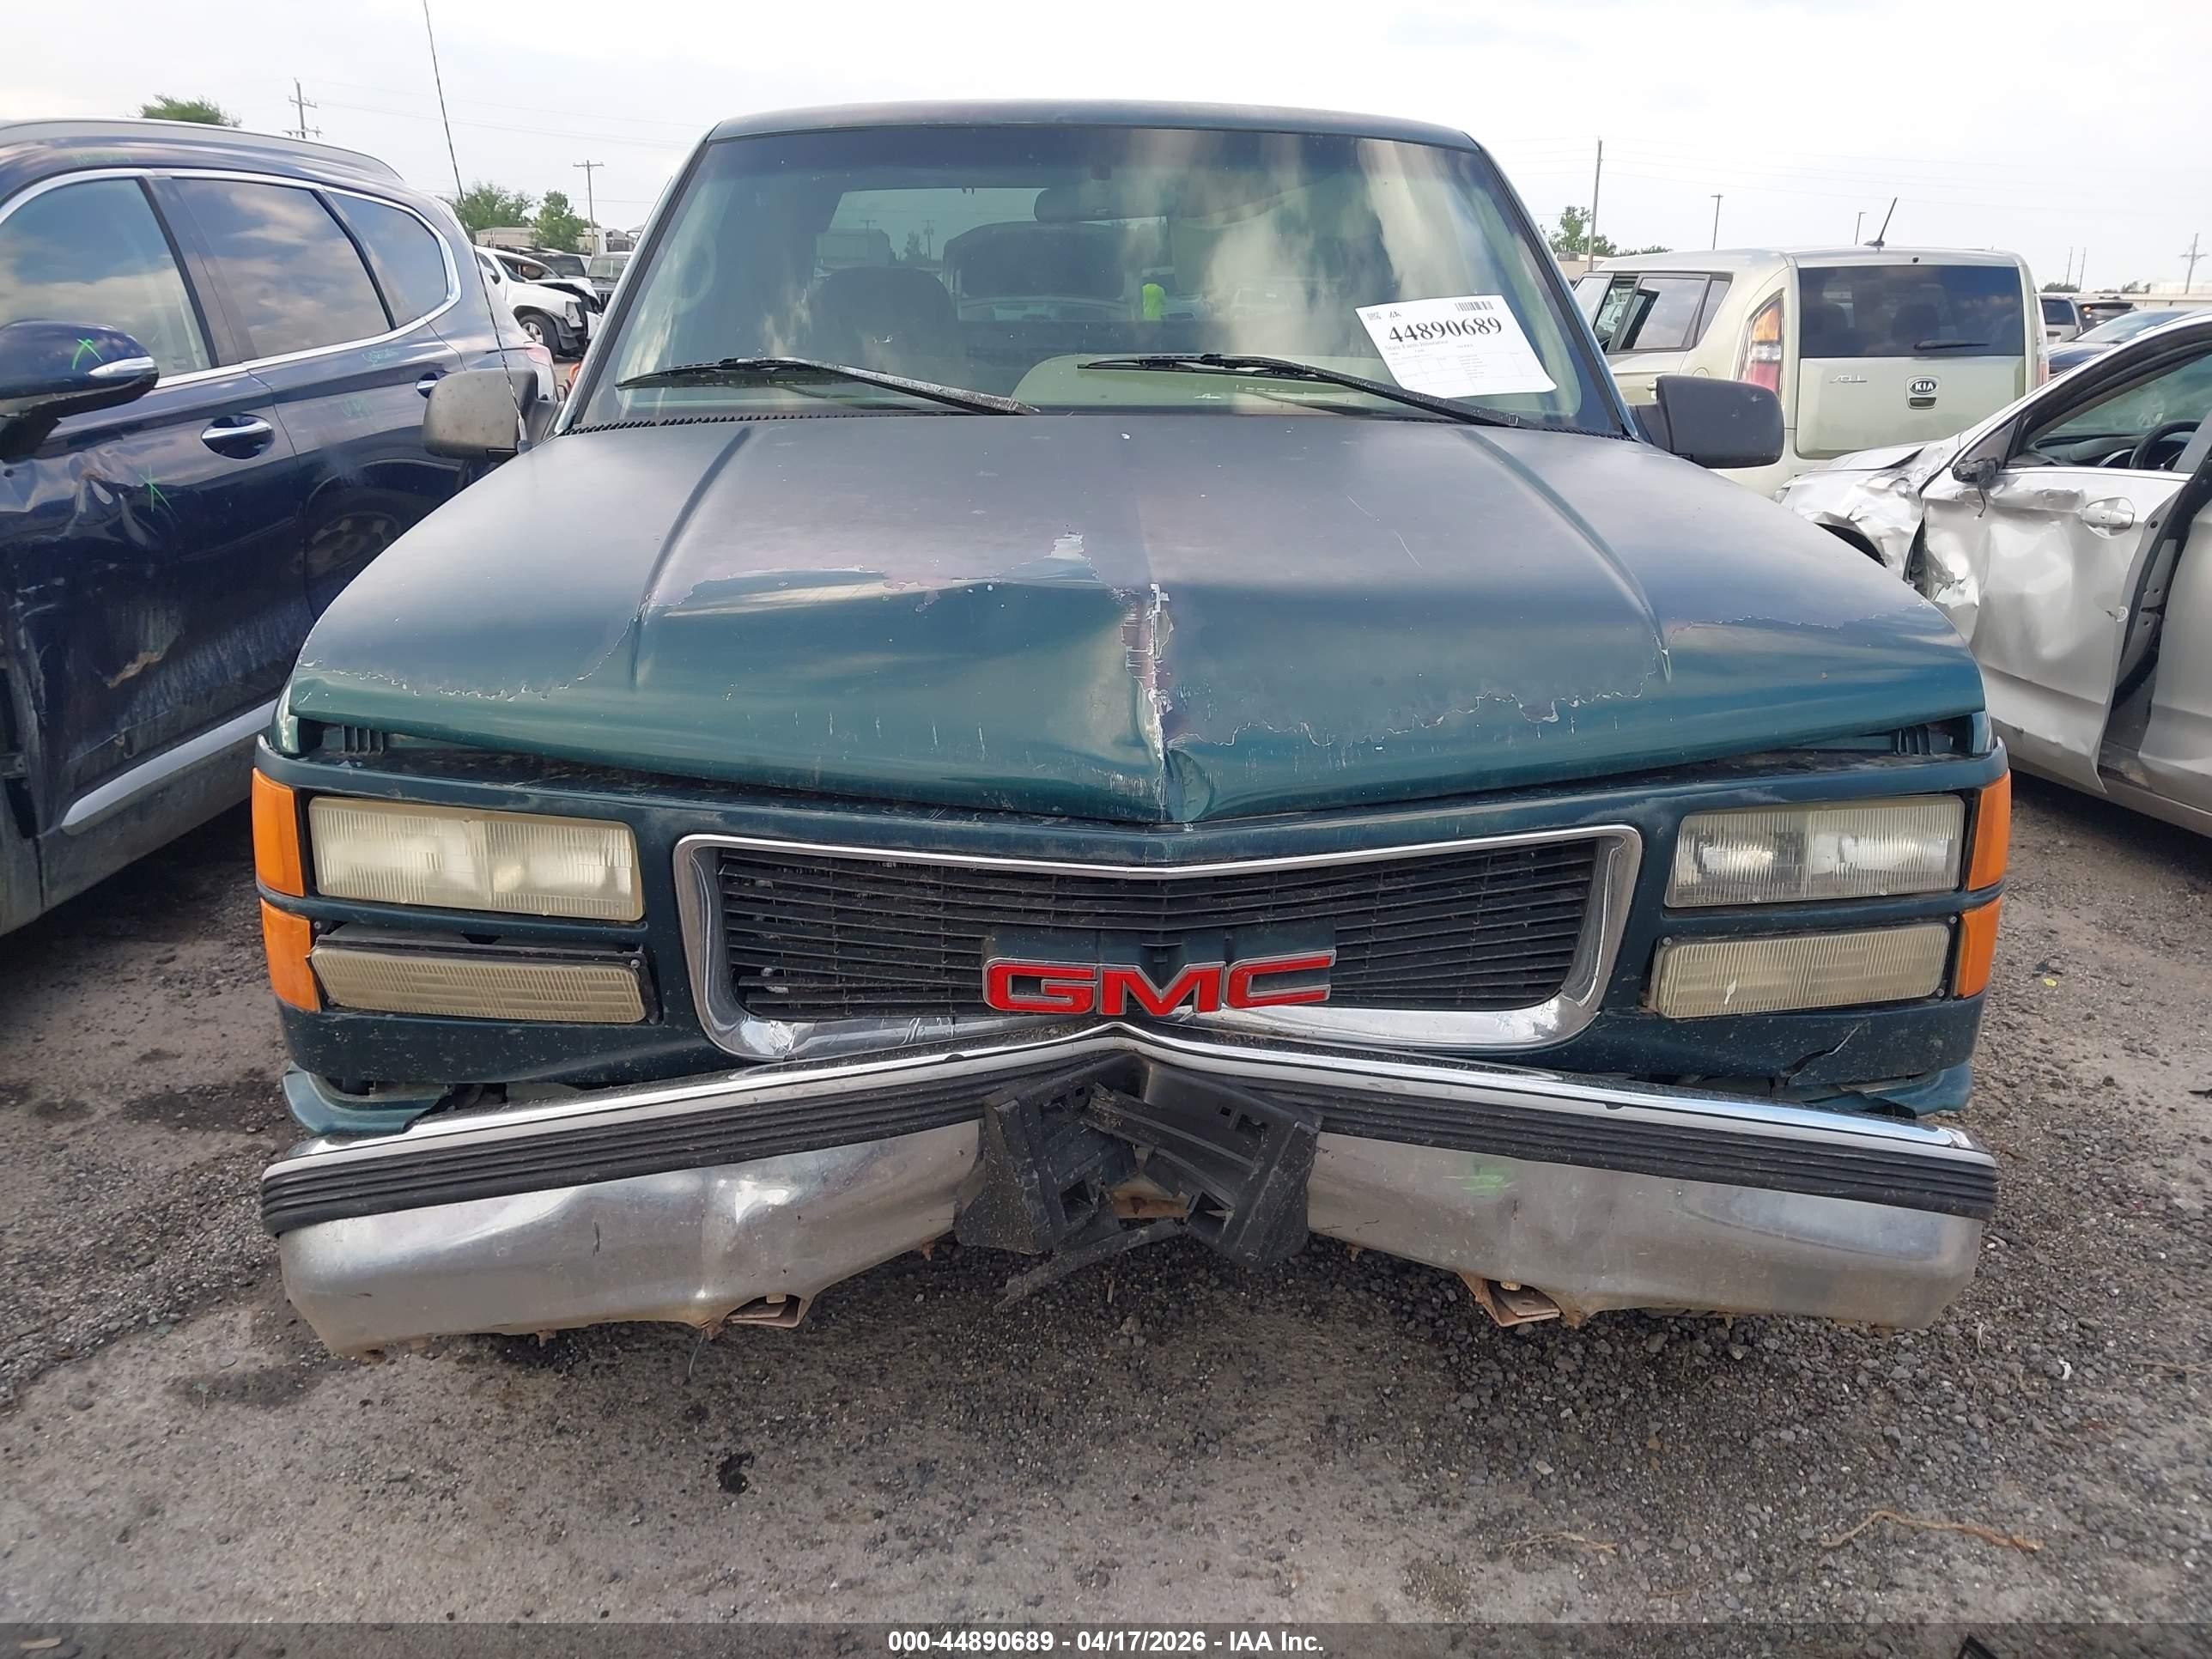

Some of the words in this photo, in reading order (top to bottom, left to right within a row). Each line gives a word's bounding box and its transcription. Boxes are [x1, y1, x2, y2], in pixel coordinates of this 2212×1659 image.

[1389, 317, 1502, 342] 44890689
[1915, 382, 1934, 392] KIA
[982, 950, 1336, 1016] GMC
